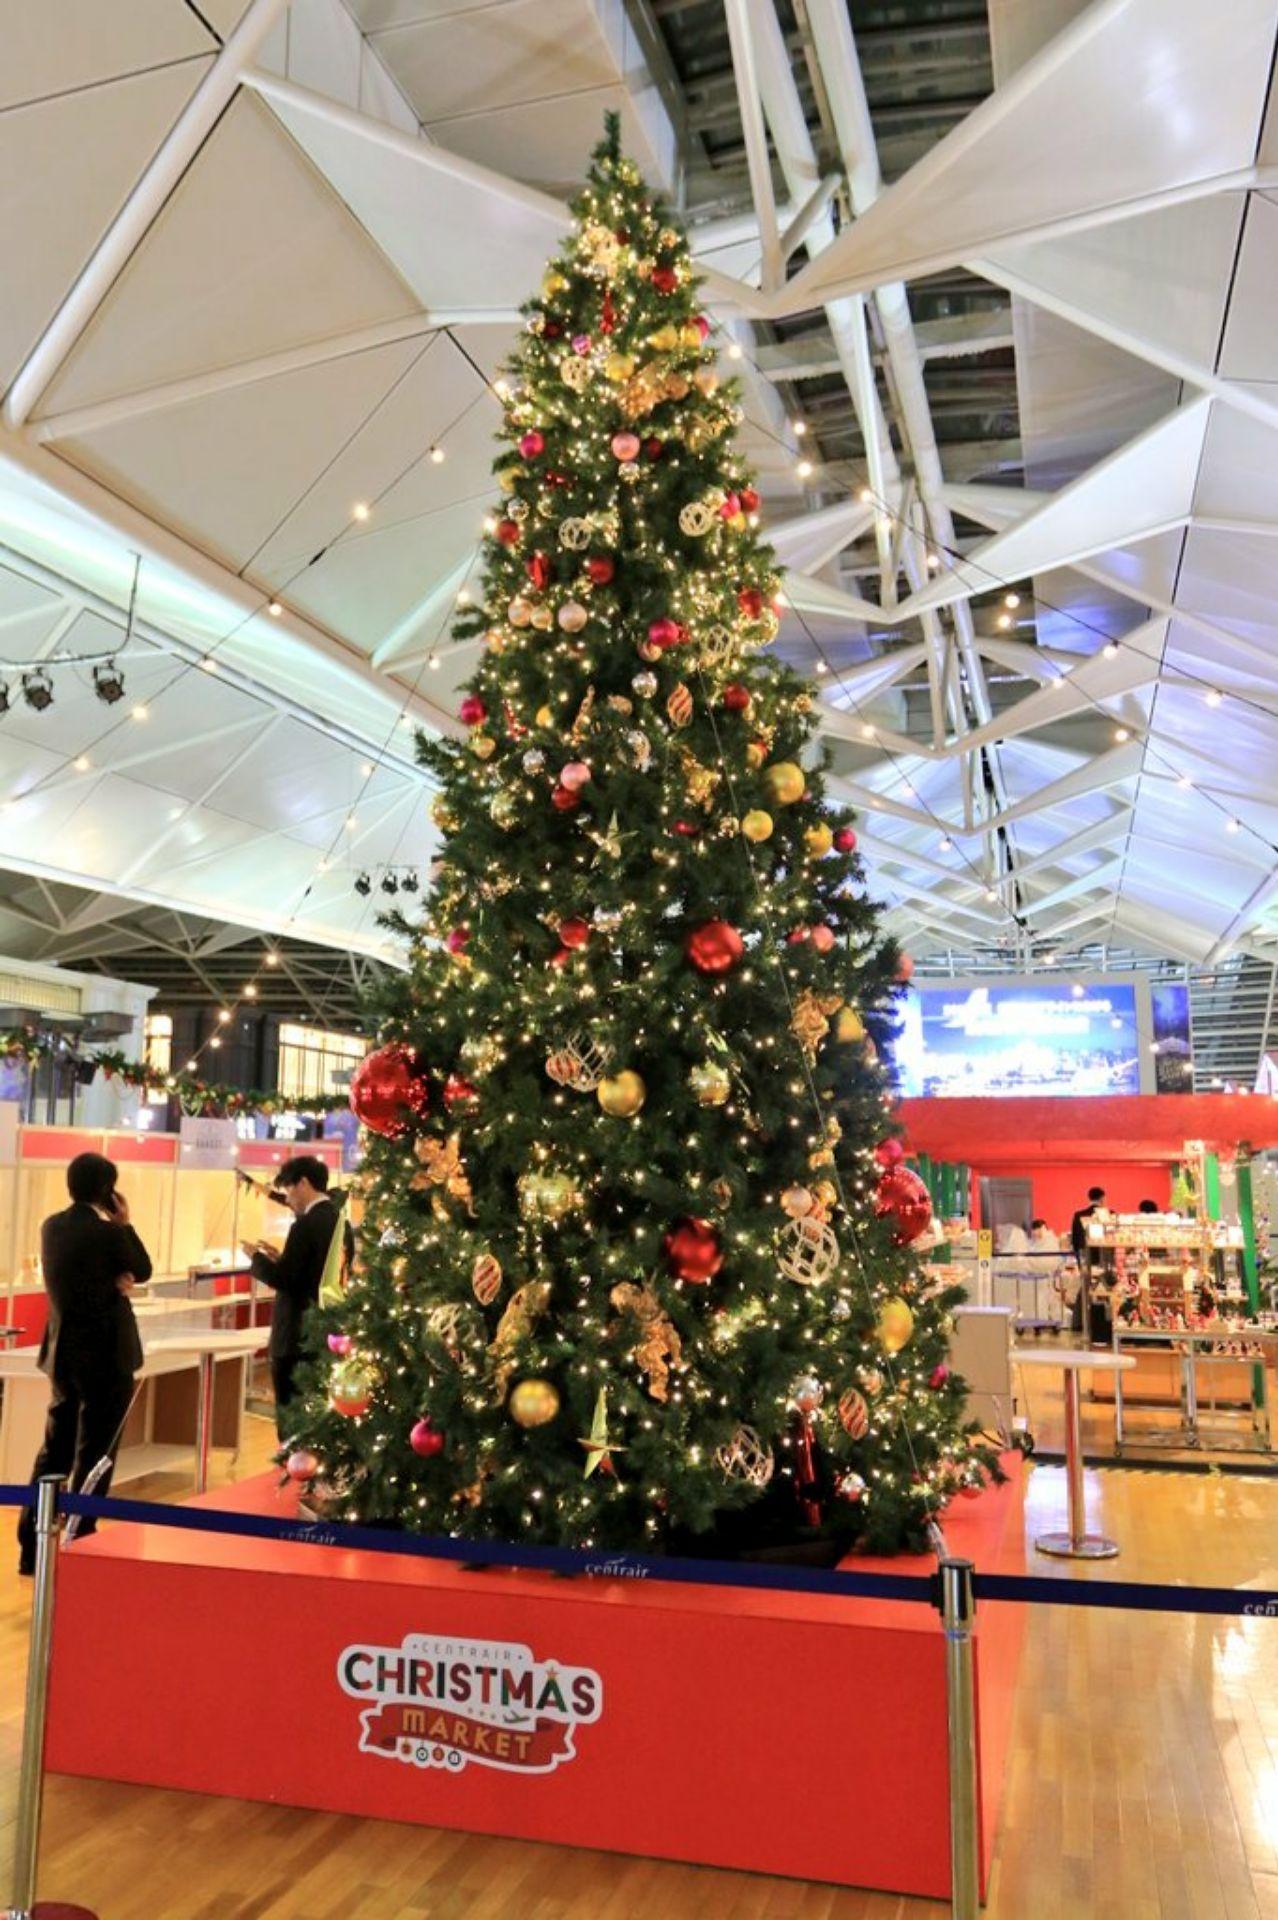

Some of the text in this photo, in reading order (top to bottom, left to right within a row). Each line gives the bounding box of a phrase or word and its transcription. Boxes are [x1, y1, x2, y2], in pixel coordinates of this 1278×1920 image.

[422, 1641, 511, 1662] CENTRAIR
[344, 1652, 596, 1716] CHRISTMAS
[402, 1708, 532, 1760] MARKET
